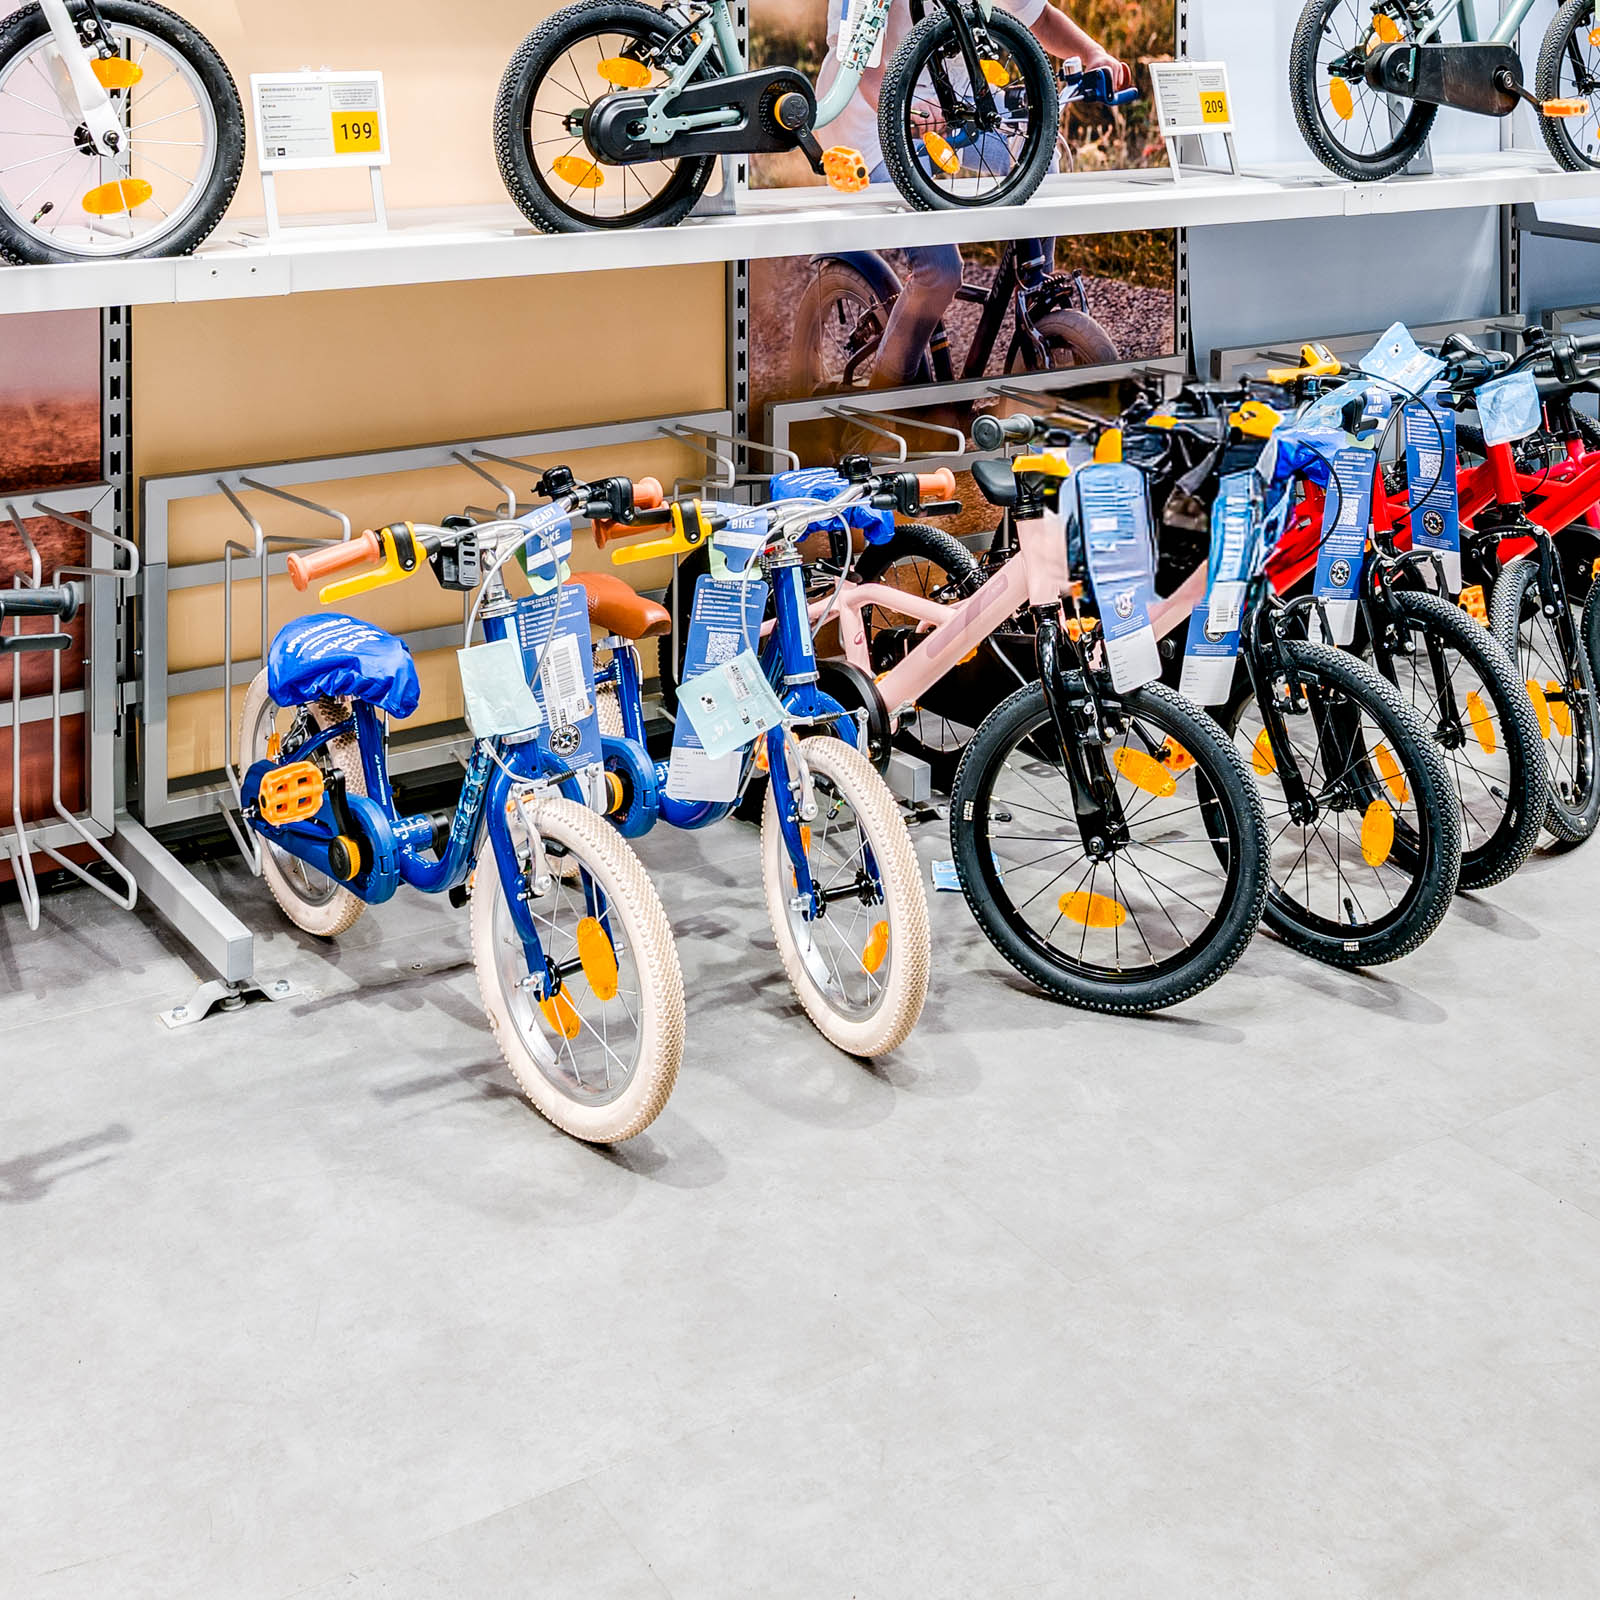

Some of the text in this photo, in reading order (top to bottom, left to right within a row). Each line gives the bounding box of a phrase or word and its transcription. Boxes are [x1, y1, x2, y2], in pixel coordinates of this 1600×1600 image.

[1373, 395, 1381, 405] TO
[1367, 404, 1383, 414] BIKE
[731, 518, 755, 530] BIKE
